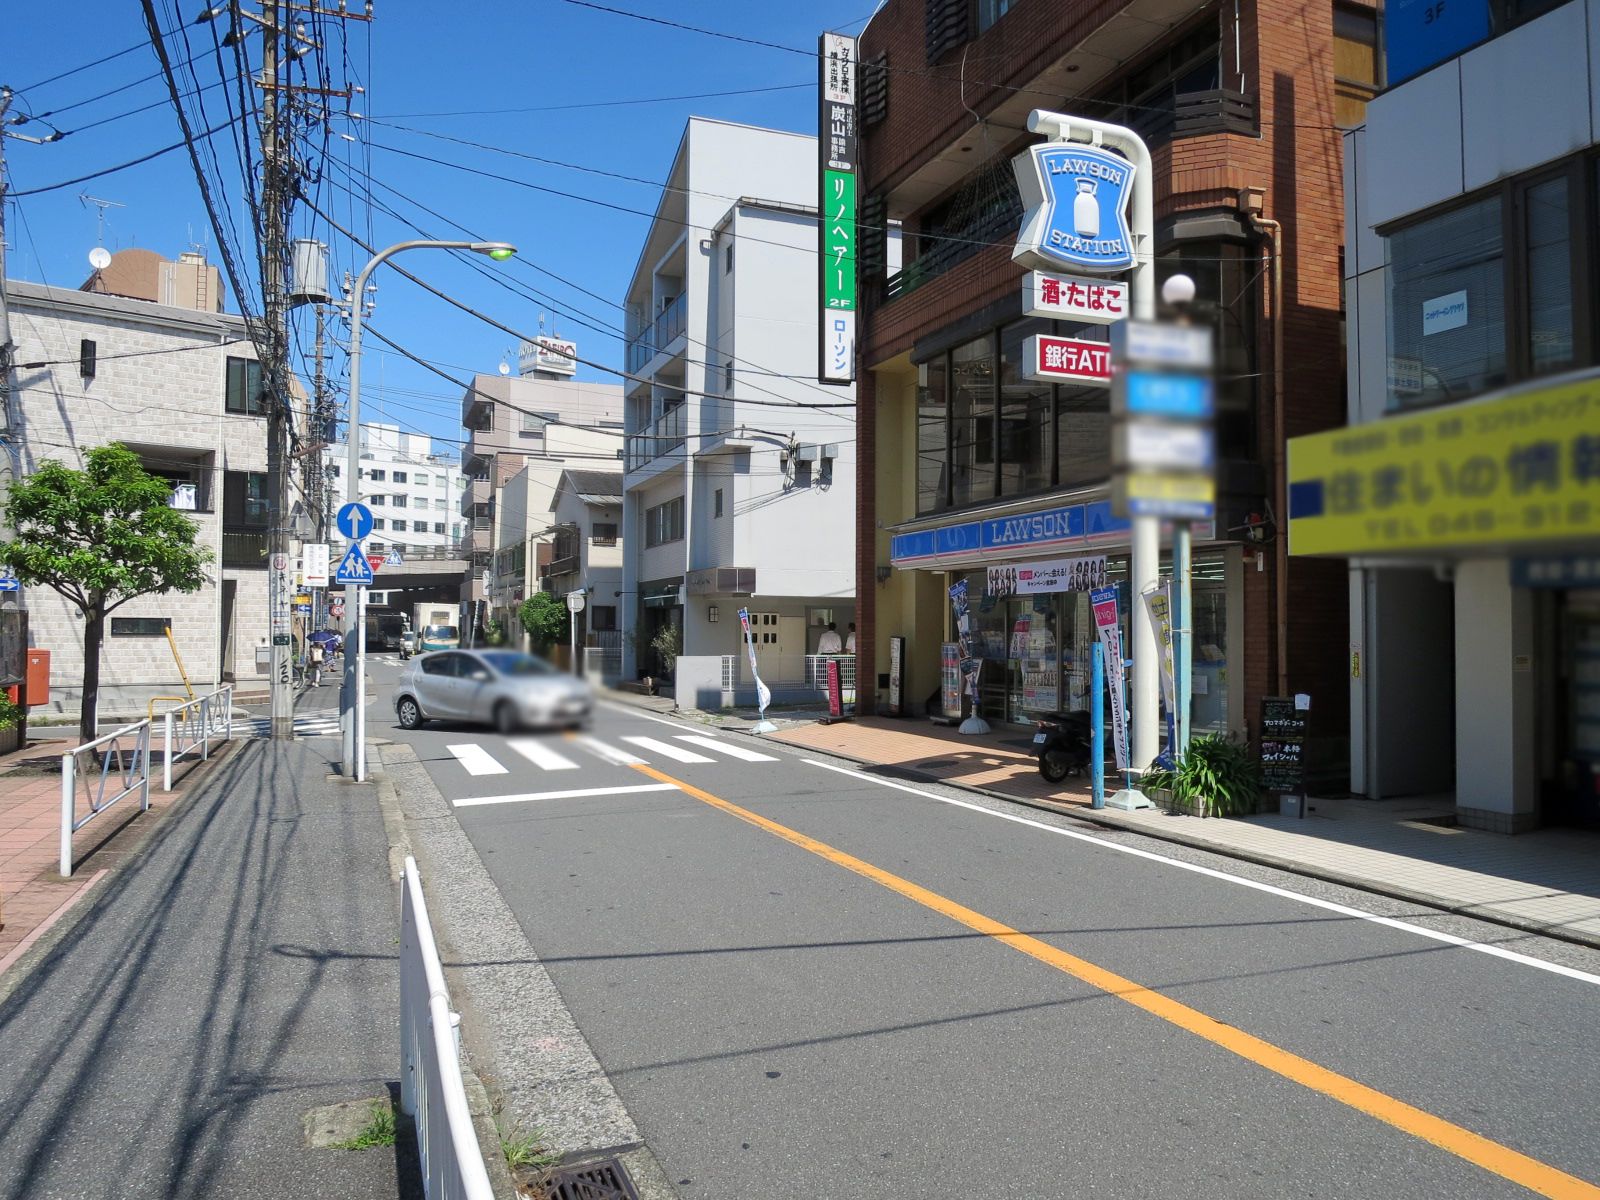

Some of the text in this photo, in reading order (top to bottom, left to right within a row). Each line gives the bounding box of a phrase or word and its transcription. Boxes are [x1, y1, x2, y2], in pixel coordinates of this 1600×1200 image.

[1424, 1, 1445, 25] 3F
[1049, 158, 1122, 187] LAWSON
[832, 178, 849, 291] リノヘアー
[1051, 229, 1123, 255] STATION
[830, 298, 851, 307] 2F
[834, 319, 846, 371] ローソン
[1045, 344, 1111, 373] 銀行AT
[991, 511, 1071, 543] LAWSON
